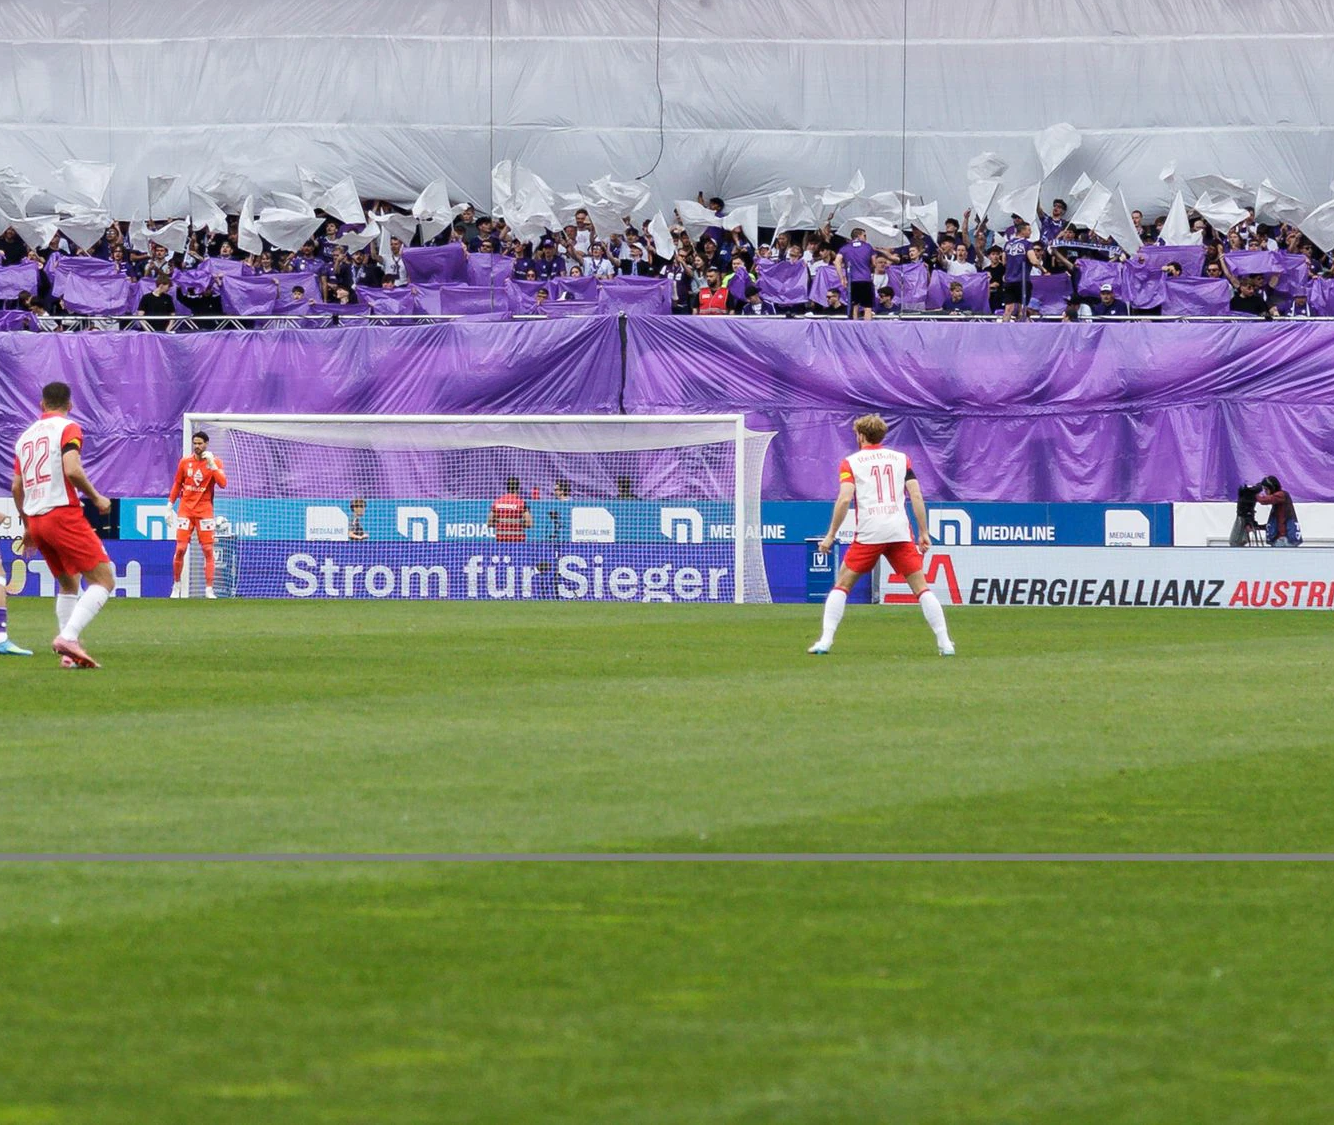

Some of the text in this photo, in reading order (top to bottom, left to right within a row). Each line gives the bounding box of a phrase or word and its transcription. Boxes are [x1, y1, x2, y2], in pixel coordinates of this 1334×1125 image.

[22, 436, 51, 488] 22
[870, 464, 896, 503] 11
[978, 526, 1055, 541] MEDIALINE
[1109, 531, 1146, 539] MEDIALINE
[285, 552, 450, 598] Strom
[557, 555, 728, 603] Sieger
[969, 578, 1224, 607] ENERGIEALLIANZ
